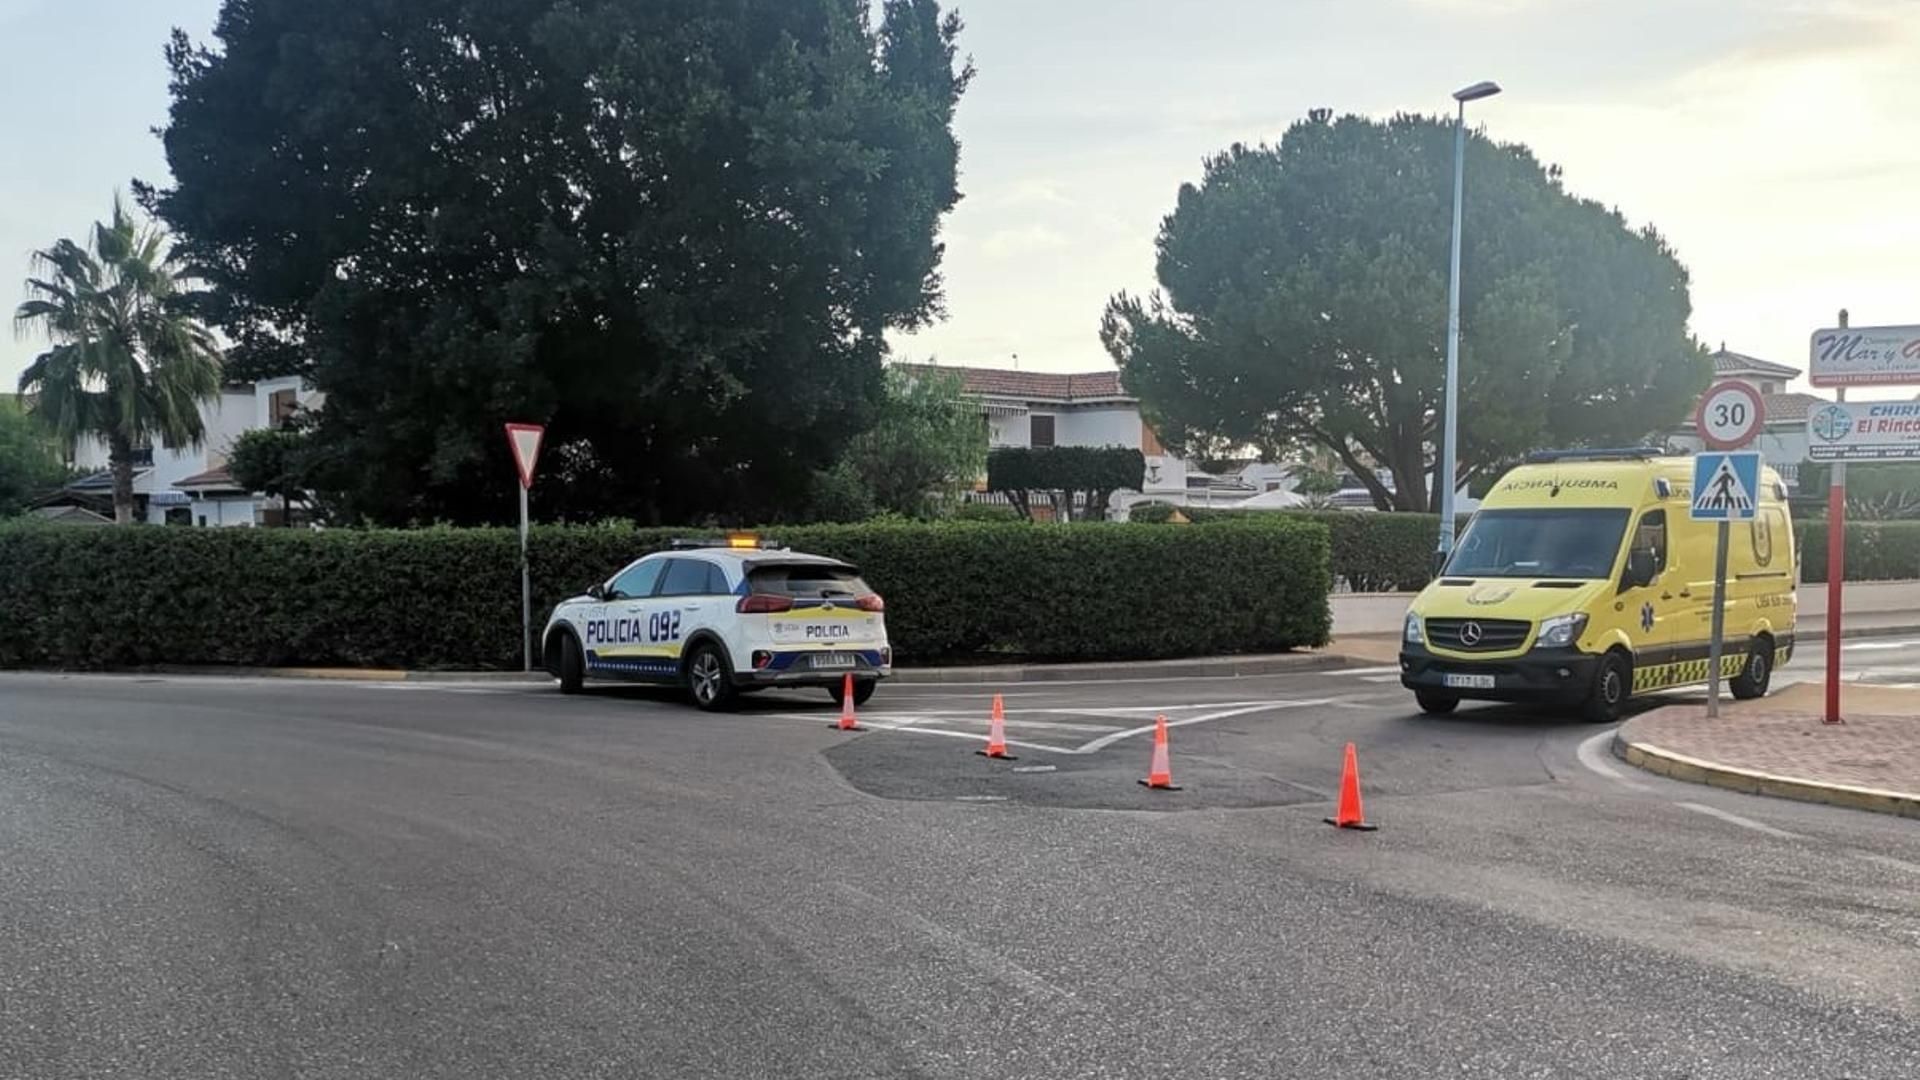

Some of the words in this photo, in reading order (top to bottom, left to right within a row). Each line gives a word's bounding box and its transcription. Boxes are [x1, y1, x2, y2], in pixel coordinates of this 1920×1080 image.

[1818, 334, 1878, 361] Mar
[1715, 403, 1745, 427] 30
[1857, 419, 1872, 433] El
[587, 618, 641, 643] POLICIA
[649, 609, 681, 641] 092
[807, 625, 849, 637] POLICIA
